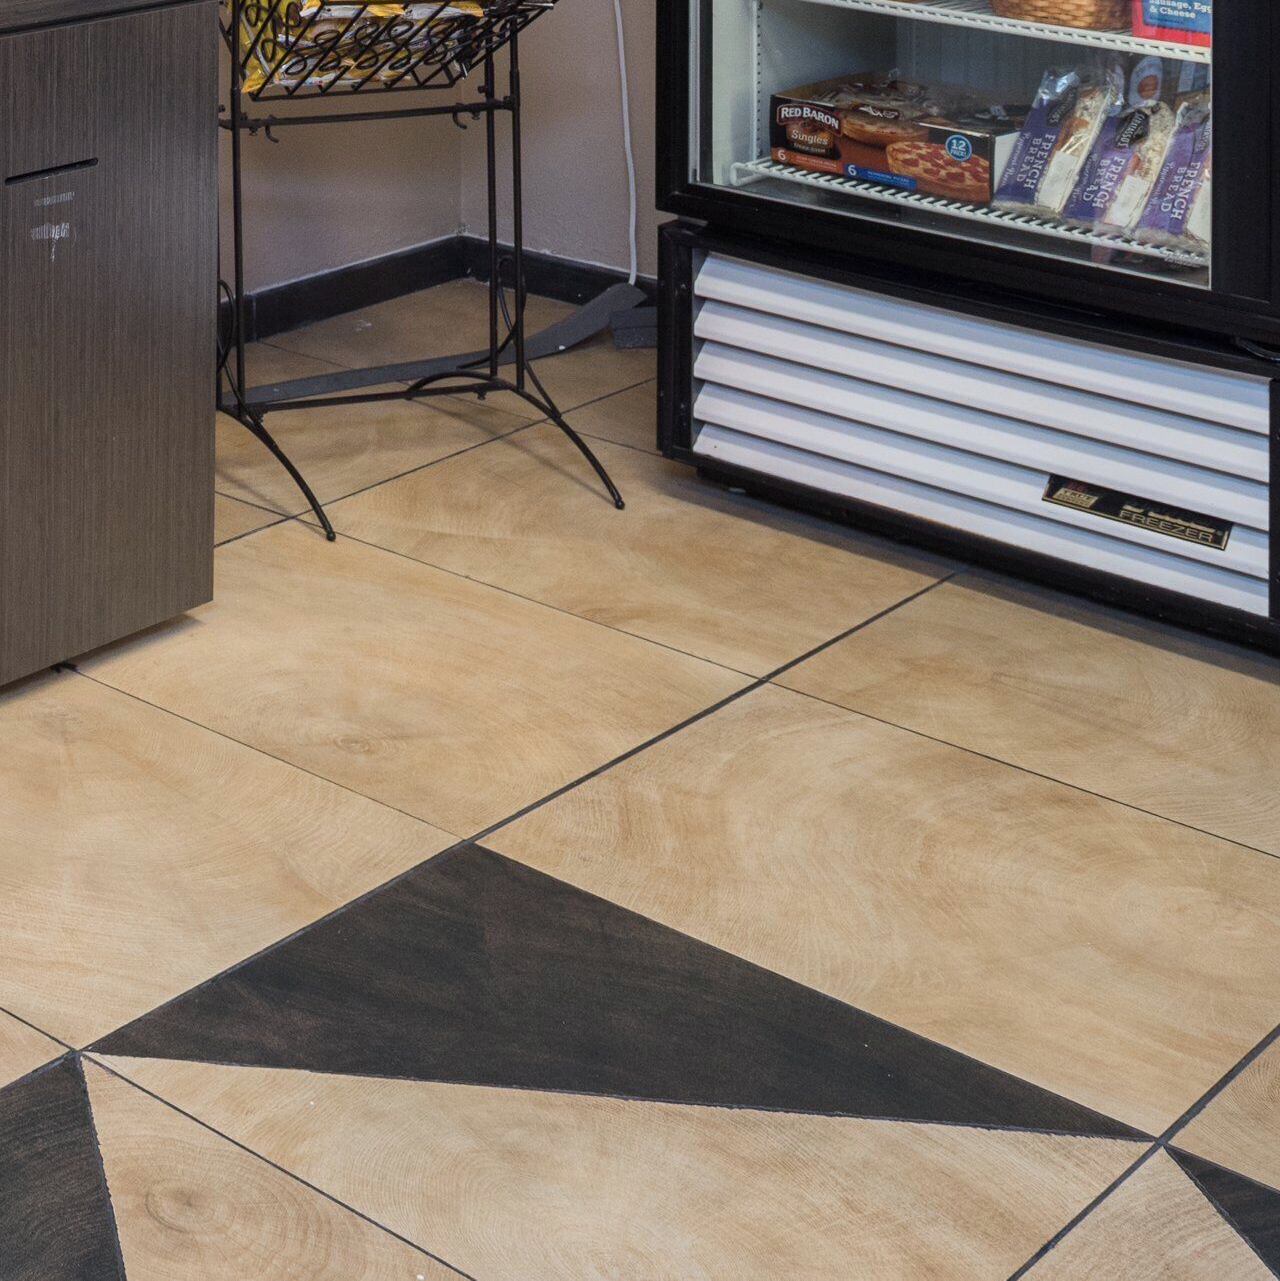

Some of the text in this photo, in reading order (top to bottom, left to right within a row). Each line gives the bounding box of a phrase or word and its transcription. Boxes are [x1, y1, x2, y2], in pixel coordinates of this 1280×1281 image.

[780, 106, 839, 130] RED BARON
[791, 128, 829, 146] Singles
[951, 139, 966, 151] 12
[1016, 138, 1042, 182] BREAD
[1024, 134, 1056, 189] FRENCH
[1083, 160, 1111, 201] BREAD
[1092, 156, 1126, 208] FRENCH
[1120, 510, 1214, 543] FREEZER
